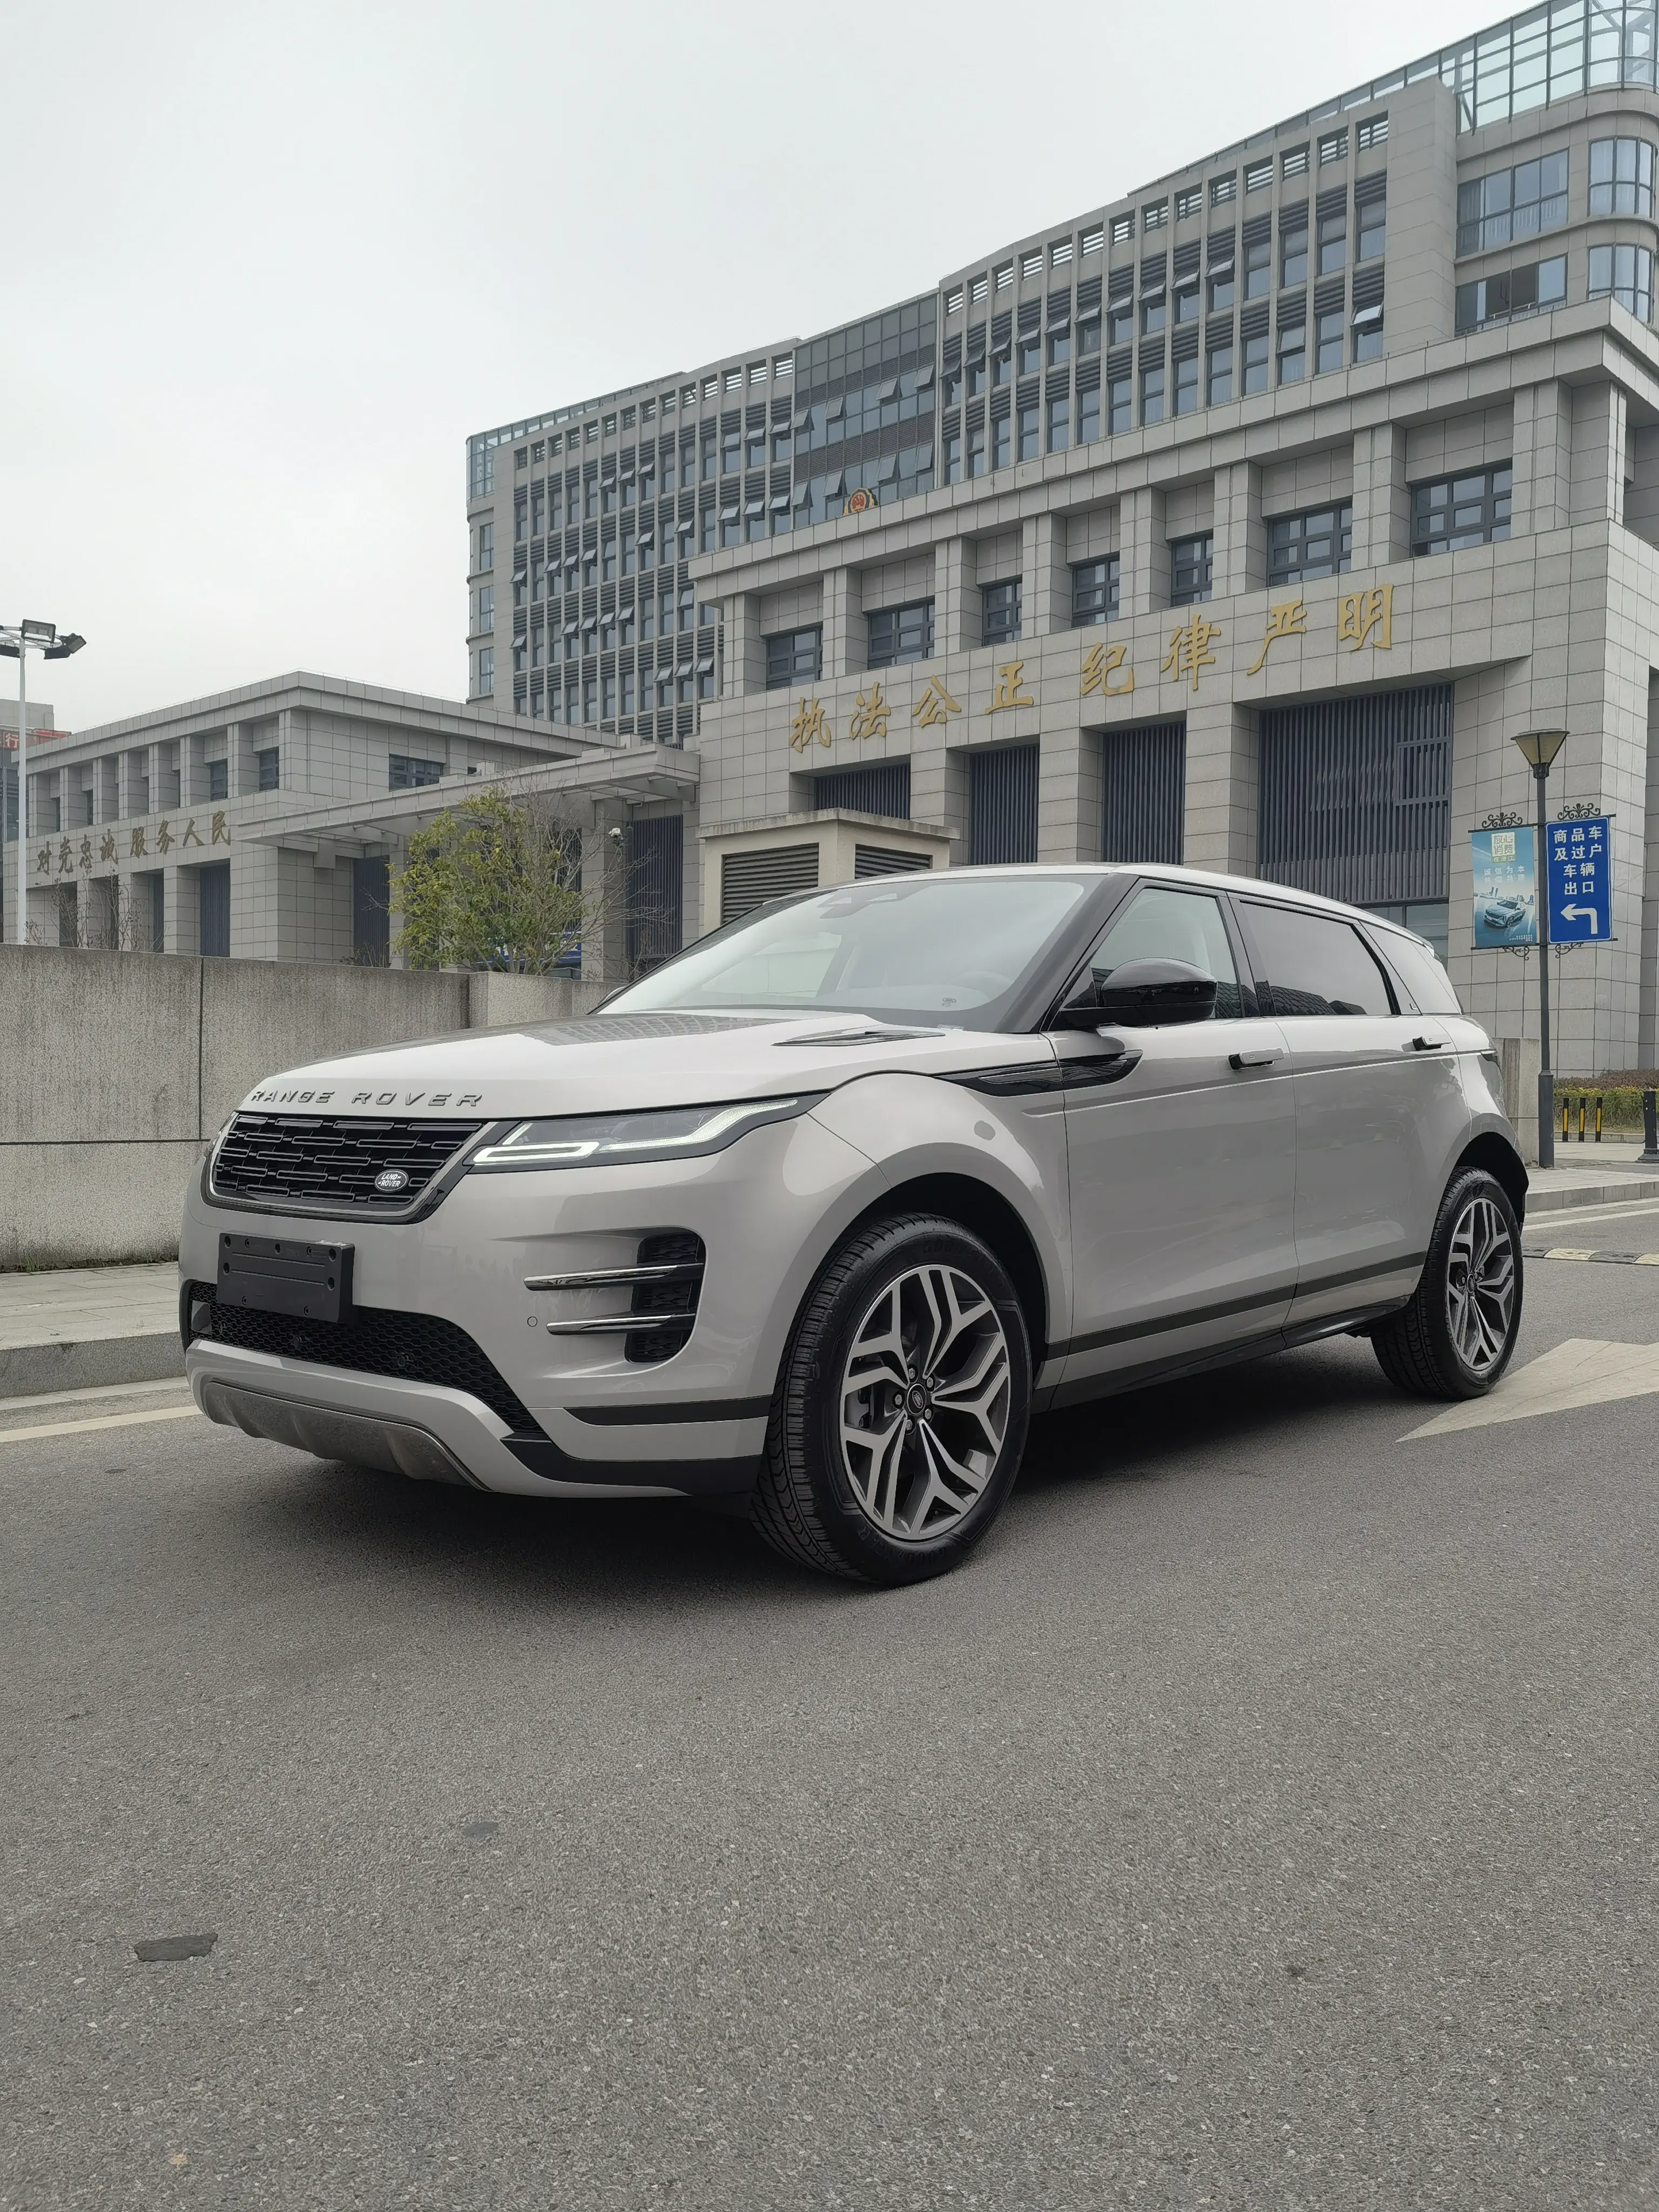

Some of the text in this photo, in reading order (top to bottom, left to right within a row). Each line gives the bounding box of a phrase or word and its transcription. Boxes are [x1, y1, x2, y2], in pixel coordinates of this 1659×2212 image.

[789, 584, 1394, 753] 执法公正 纪律严明
[130, 810, 231, 859] 服务人民
[1493, 834, 1513, 845] 放心
[1553, 825, 1603, 844] 商品车
[1493, 844, 1514, 855] 消费
[1554, 843, 1602, 861] 及过户
[1563, 862, 1595, 878] 车辆
[1564, 880, 1594, 895] 出口
[250, 1089, 483, 1107] RANGE ROVER
